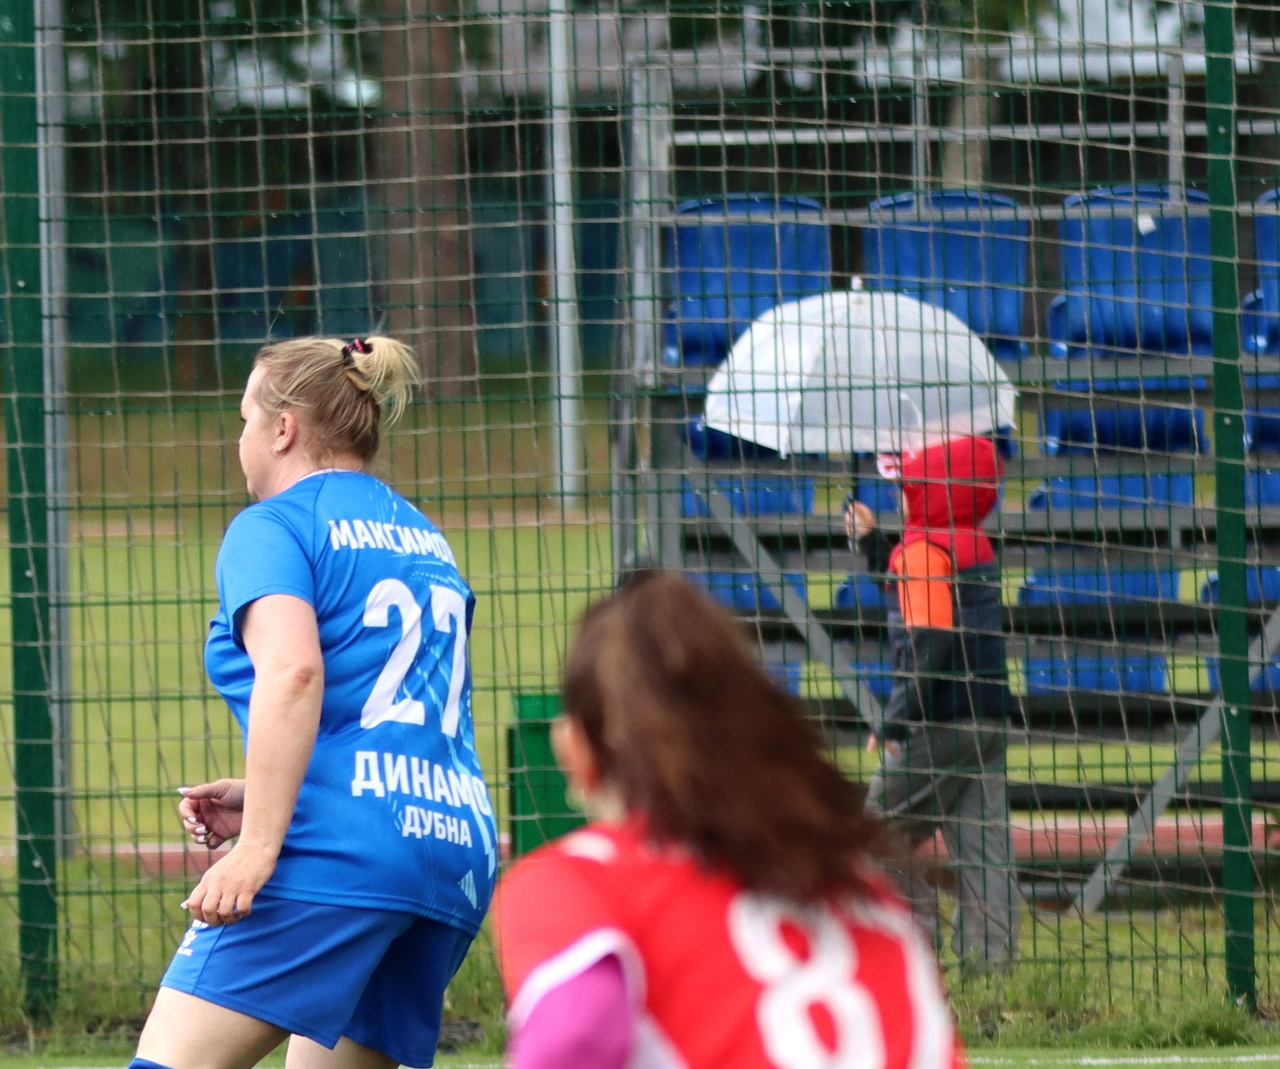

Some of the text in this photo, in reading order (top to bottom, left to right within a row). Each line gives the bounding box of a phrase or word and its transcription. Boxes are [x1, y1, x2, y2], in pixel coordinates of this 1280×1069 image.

[328, 519, 458, 568] МАКСИМО
[361, 578, 467, 738] 27
[351, 751, 492, 817] ДИНАМО
[402, 805, 473, 848] ДУБНА
